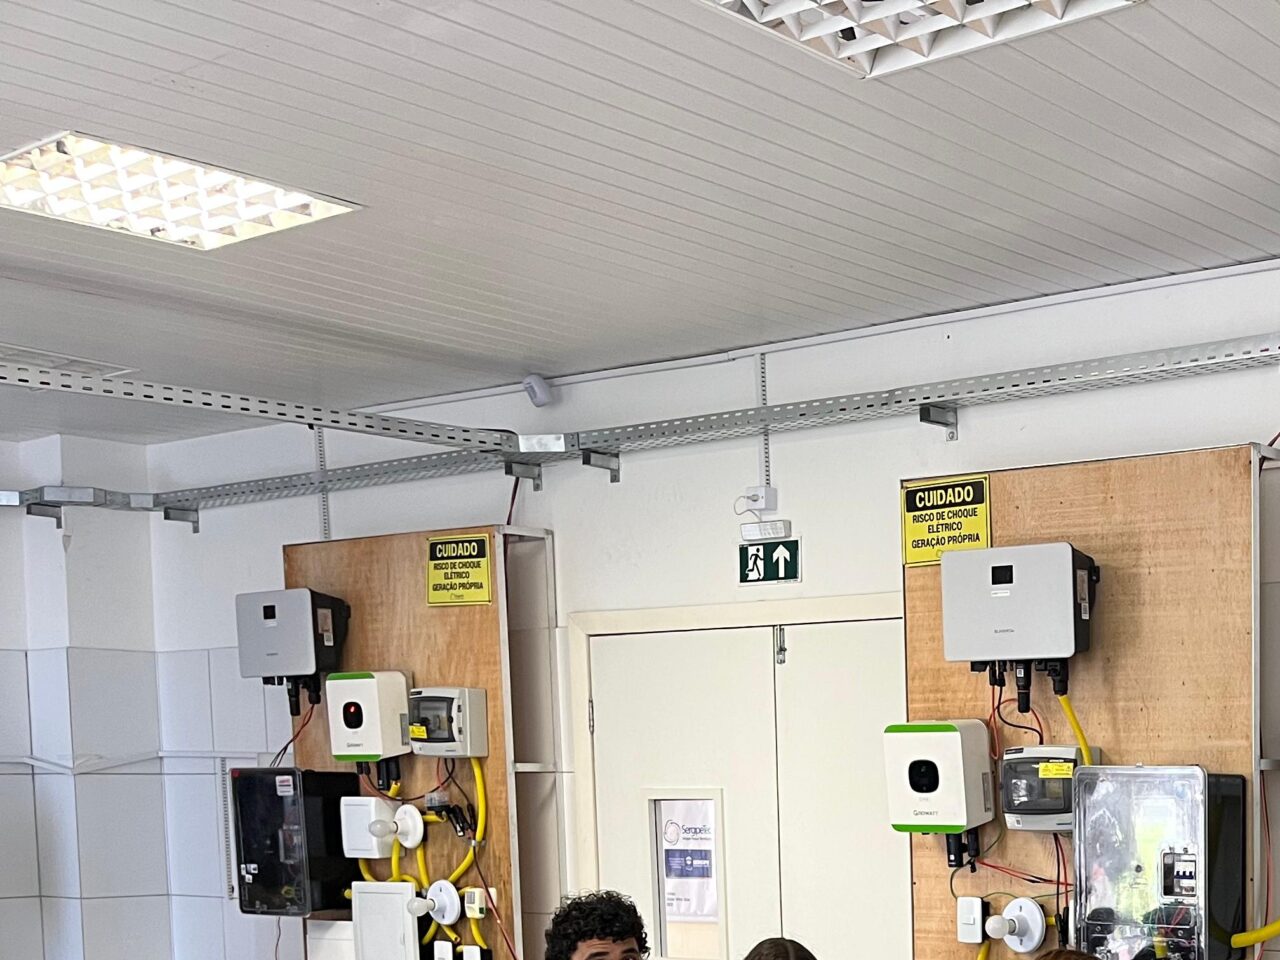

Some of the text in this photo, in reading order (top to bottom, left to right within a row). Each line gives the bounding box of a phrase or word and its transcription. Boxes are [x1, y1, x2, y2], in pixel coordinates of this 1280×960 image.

[915, 485, 974, 508] CUIDADO
[912, 508, 978, 524] RISCO DE CHOQUE
[928, 521, 963, 534] ELÉTRICO
[911, 532, 980, 549] GERAÇÃO PRÓPRIA
[436, 542, 478, 558] CUIDADO
[433, 561, 481, 570] RISCO DE CHOQUE
[444, 571, 470, 579] ELÉTRICO
[432, 581, 483, 592] GERAÇÃO PRÓPRIA
